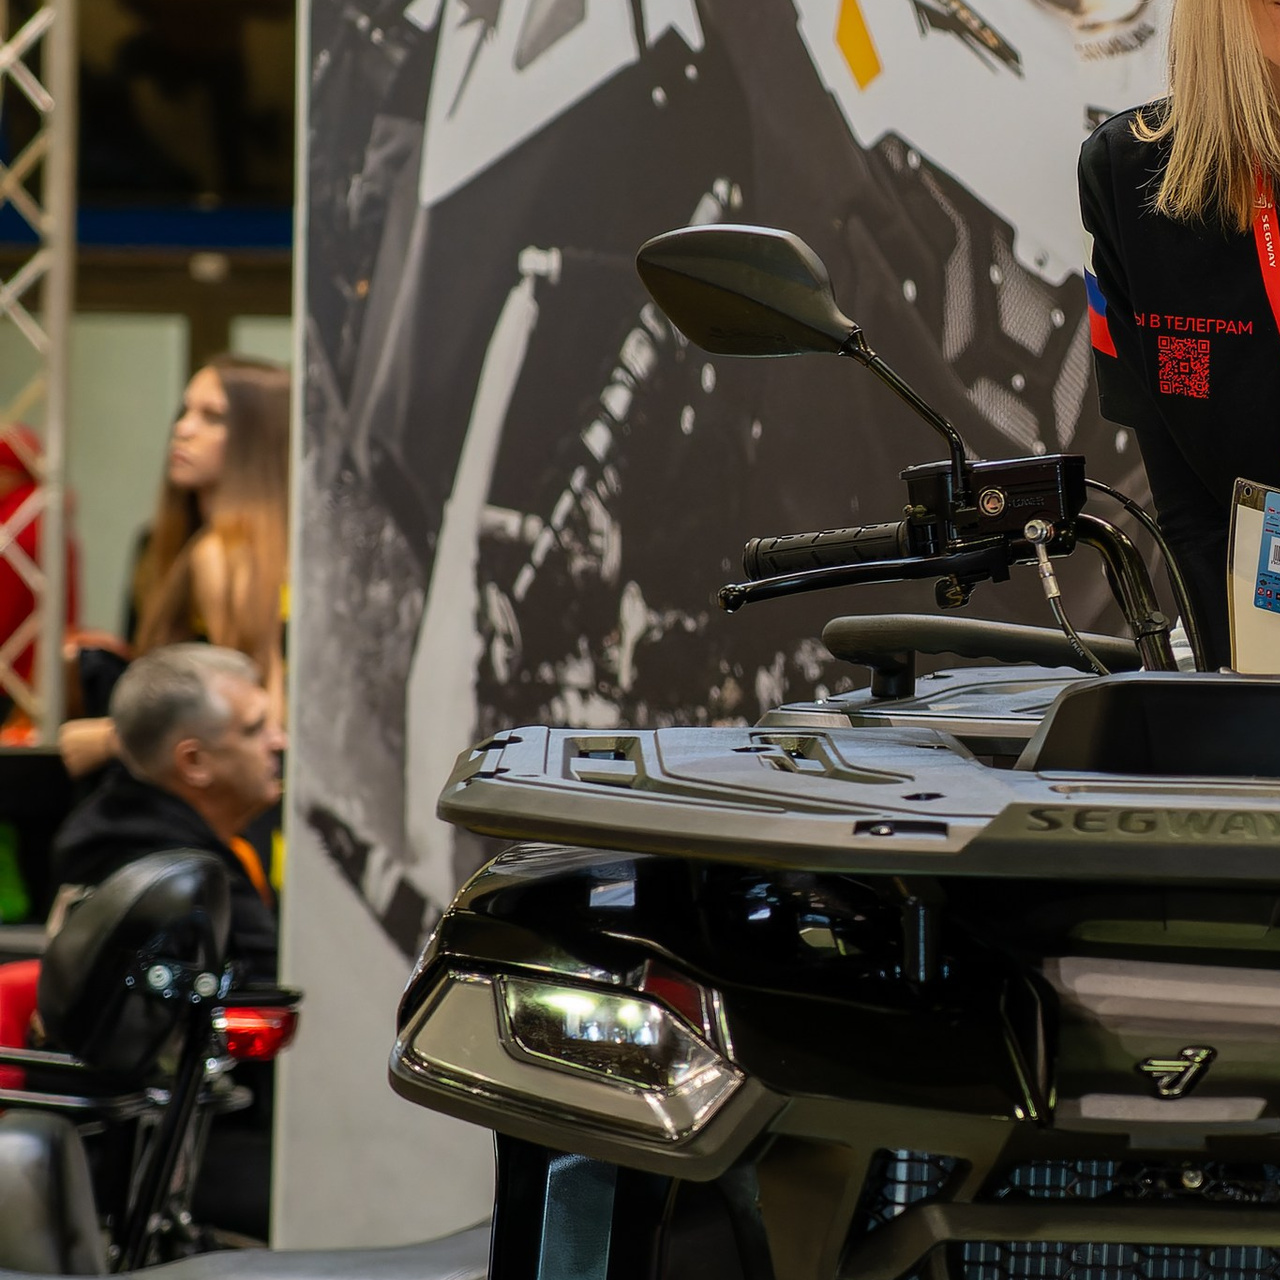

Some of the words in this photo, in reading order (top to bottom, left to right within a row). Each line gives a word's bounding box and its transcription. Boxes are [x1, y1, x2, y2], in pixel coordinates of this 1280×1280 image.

[1262, 214, 1276, 268] SEGWAY
[1150, 314, 1160, 328] В
[1164, 315, 1253, 335] ТЕЛЕГРАМ
